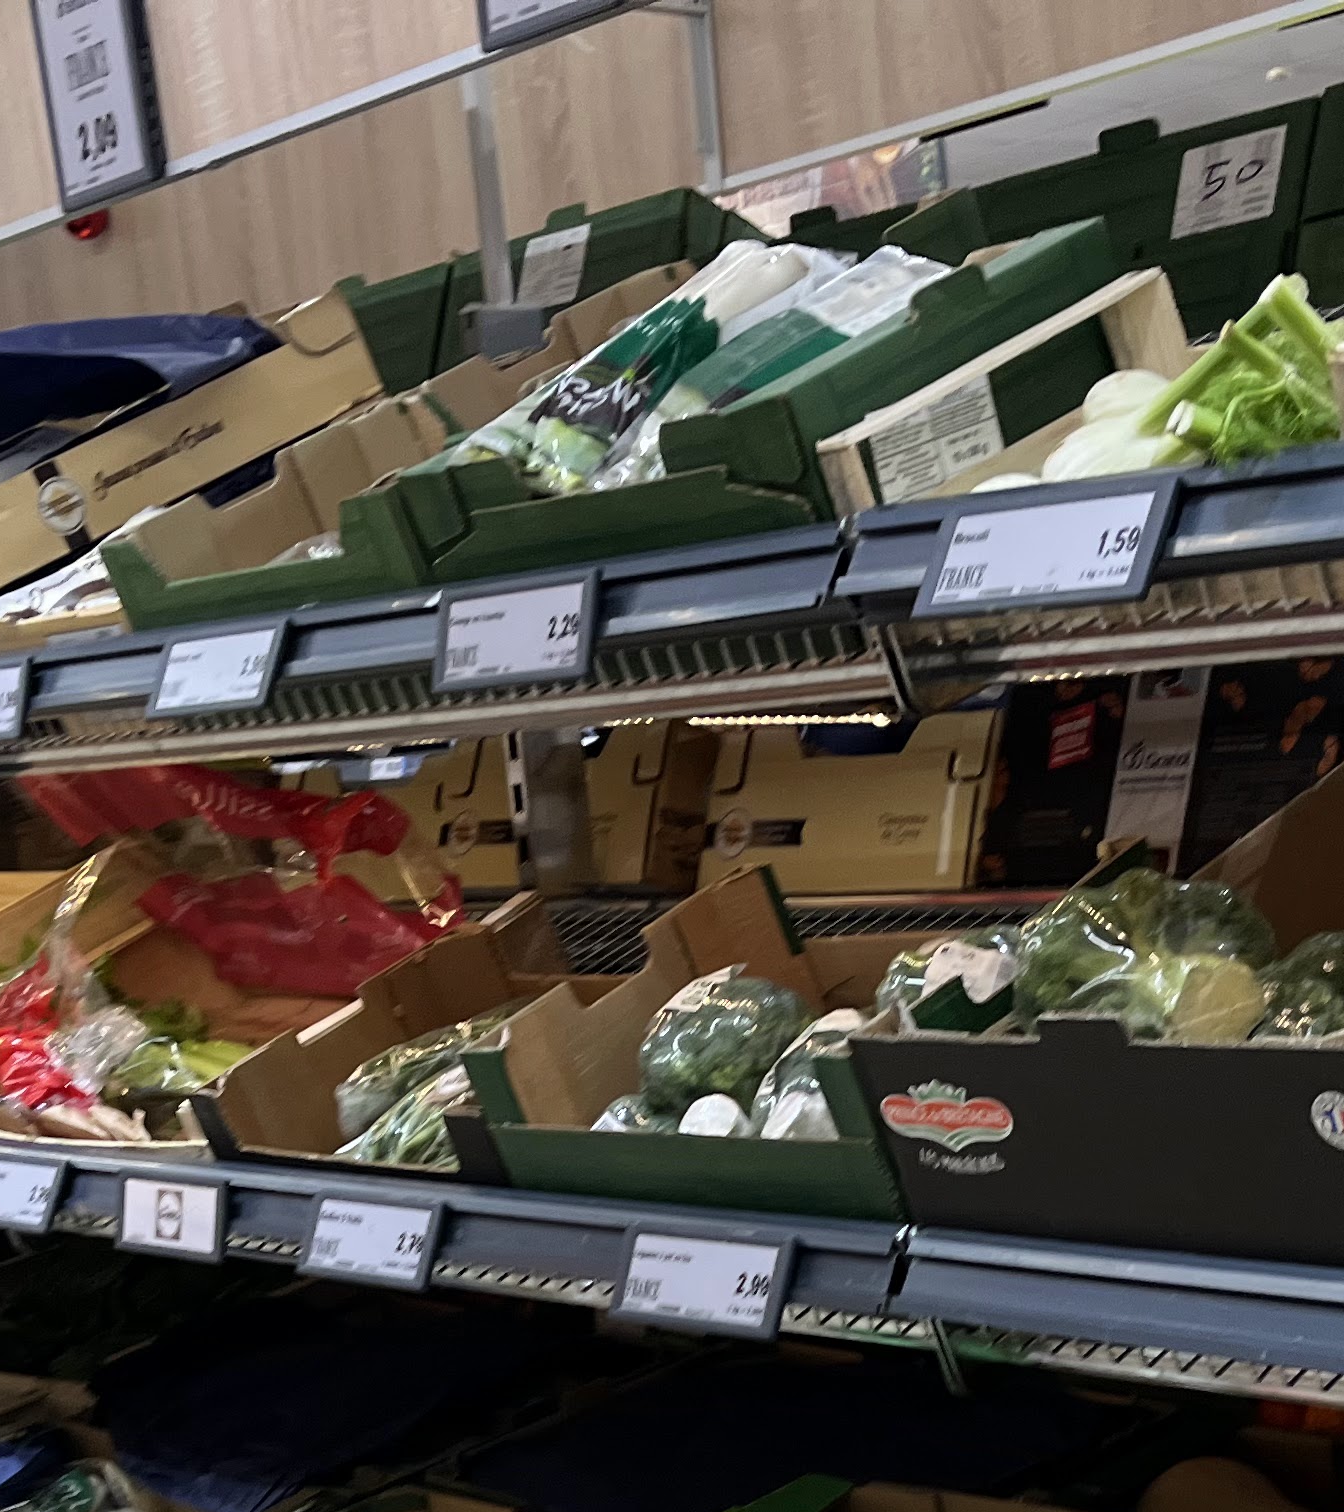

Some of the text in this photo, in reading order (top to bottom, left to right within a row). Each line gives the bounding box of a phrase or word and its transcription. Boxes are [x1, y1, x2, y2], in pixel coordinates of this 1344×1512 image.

[1197, 159, 1266, 203] 50
[1097, 526, 1143, 559] 1,59
[937, 563, 989, 591] FRANCE
